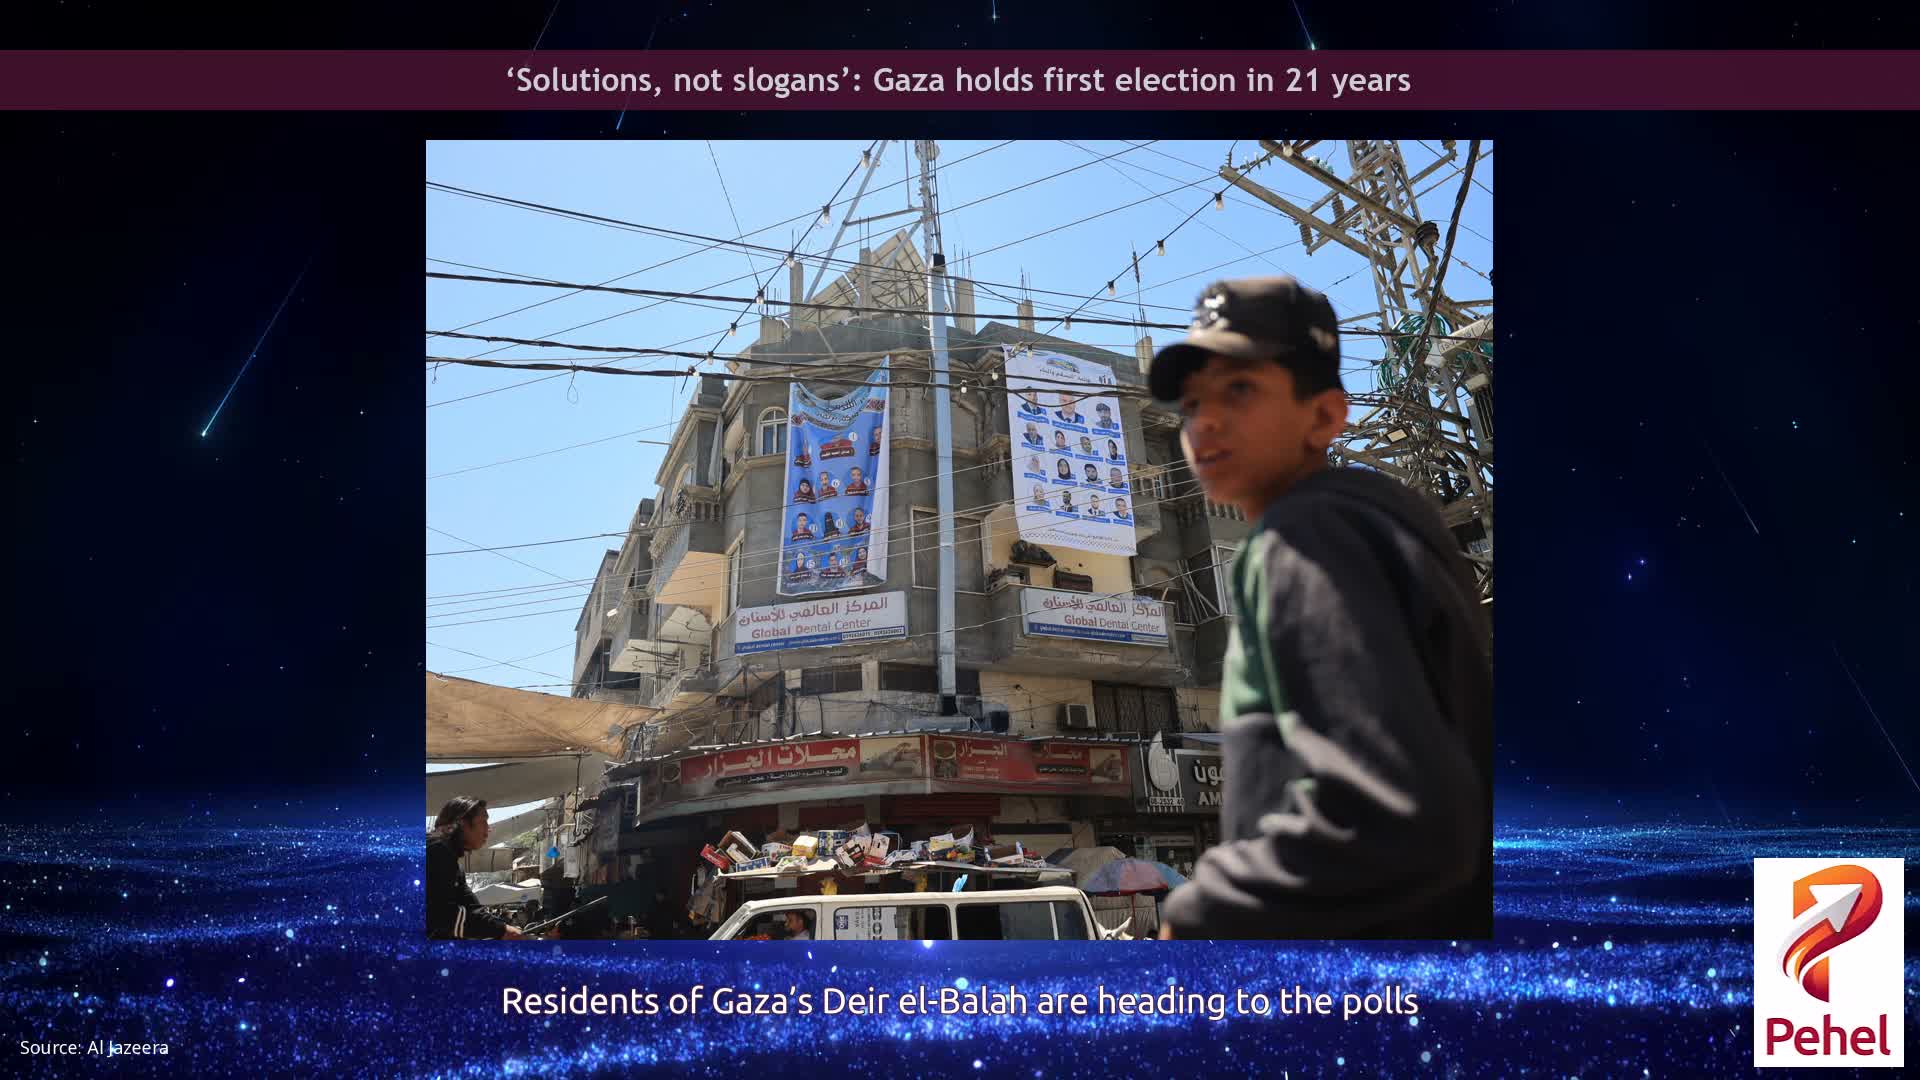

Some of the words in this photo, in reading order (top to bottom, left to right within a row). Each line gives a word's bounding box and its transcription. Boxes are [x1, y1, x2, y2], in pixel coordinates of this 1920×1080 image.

[789, 602, 839, 622] العالمي
[845, 597, 888, 616] المركز
[1043, 595, 1084, 611] للأسنان
[1085, 600, 1127, 613] العالمي
[1133, 602, 1166, 617] المركز
[738, 606, 785, 626] للأسنان
[1064, 615, 1097, 627] Global
[1100, 618, 1129, 631] Dental
[1132, 622, 1159, 633] Center
[752, 625, 791, 639] Global
[796, 621, 831, 634] Dental
[835, 618, 871, 630] Center
[703, 747, 772, 777] الجزار
[1199, 791, 1224, 806] AM
